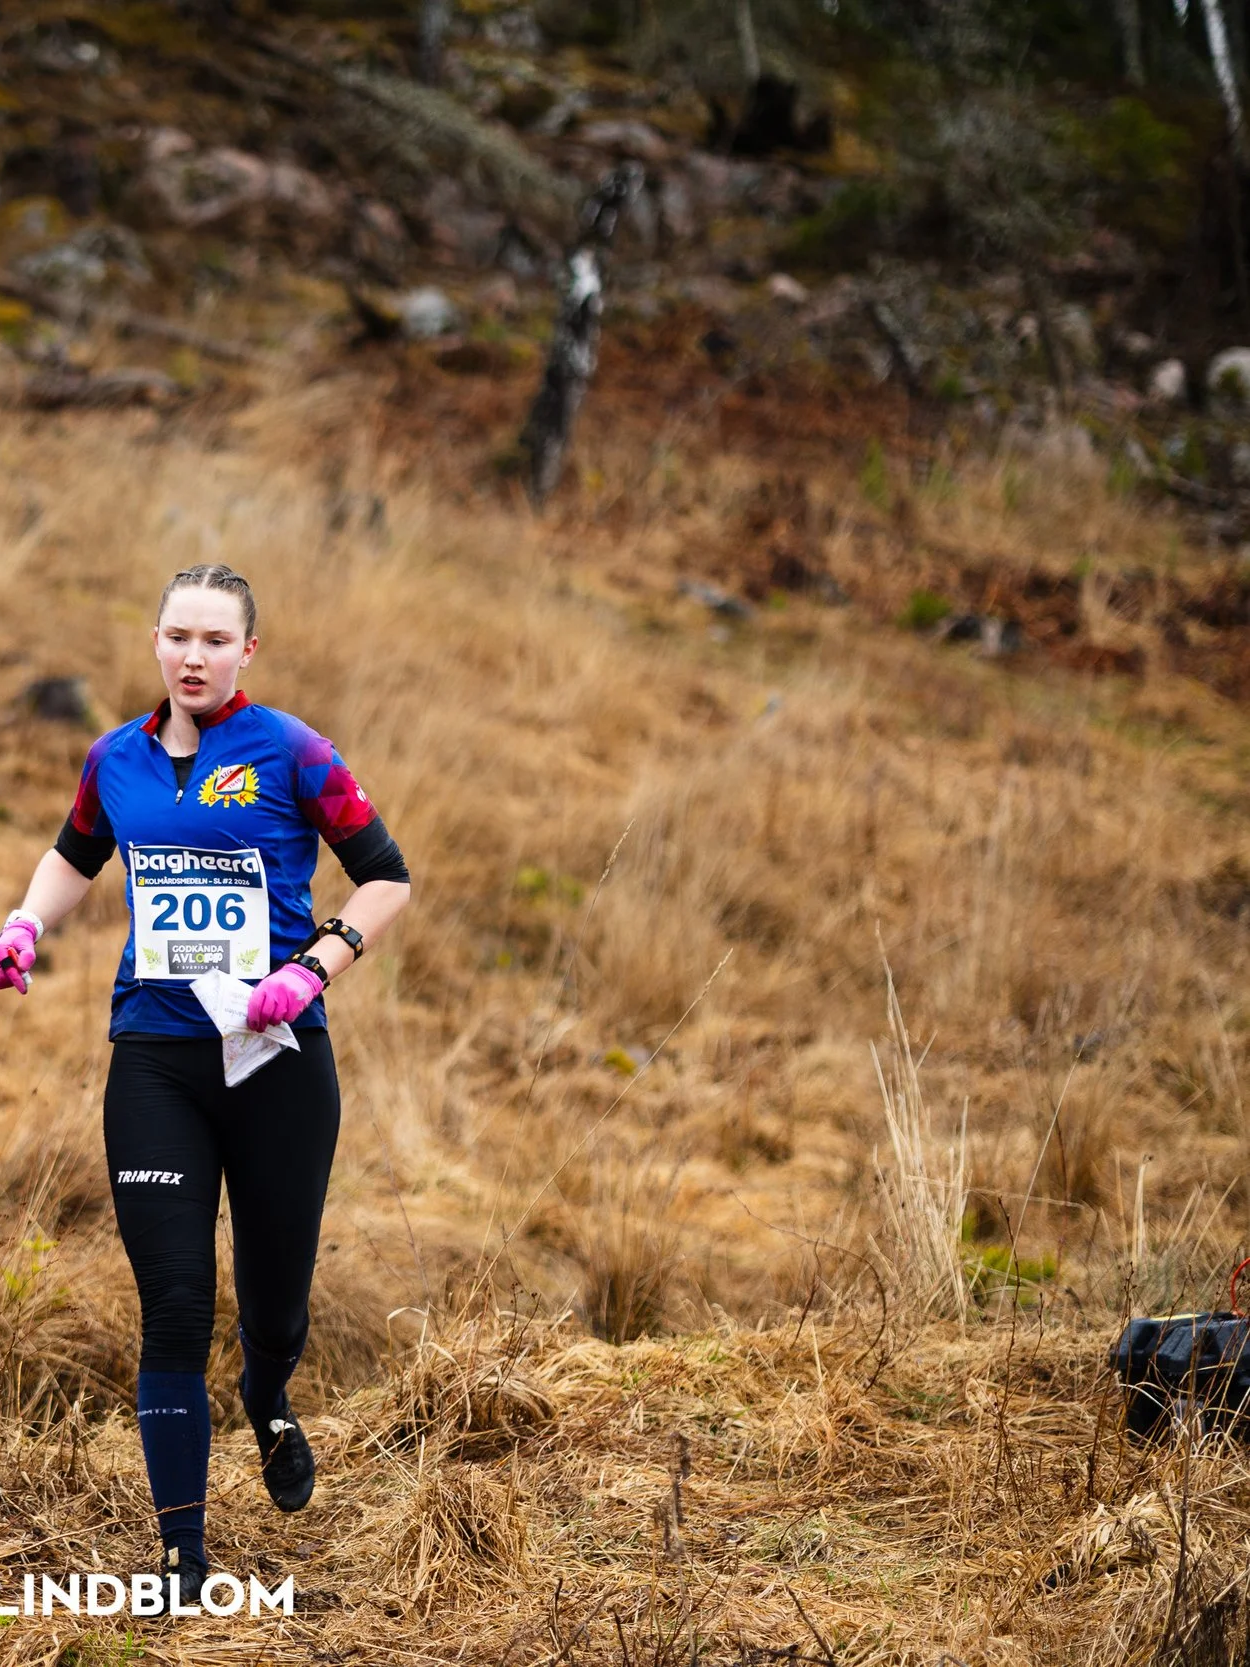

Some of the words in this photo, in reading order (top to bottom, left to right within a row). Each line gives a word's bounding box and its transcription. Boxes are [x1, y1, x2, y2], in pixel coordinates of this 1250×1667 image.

[134, 851, 260, 874] bagheera
[145, 876, 208, 886] KOLMÅRDSMEDELN
[233, 878, 250, 886] 2026
[151, 893, 246, 931] 206
[172, 944, 224, 953] GODKÄNDA
[118, 1170, 184, 1185] TRIMTEX
